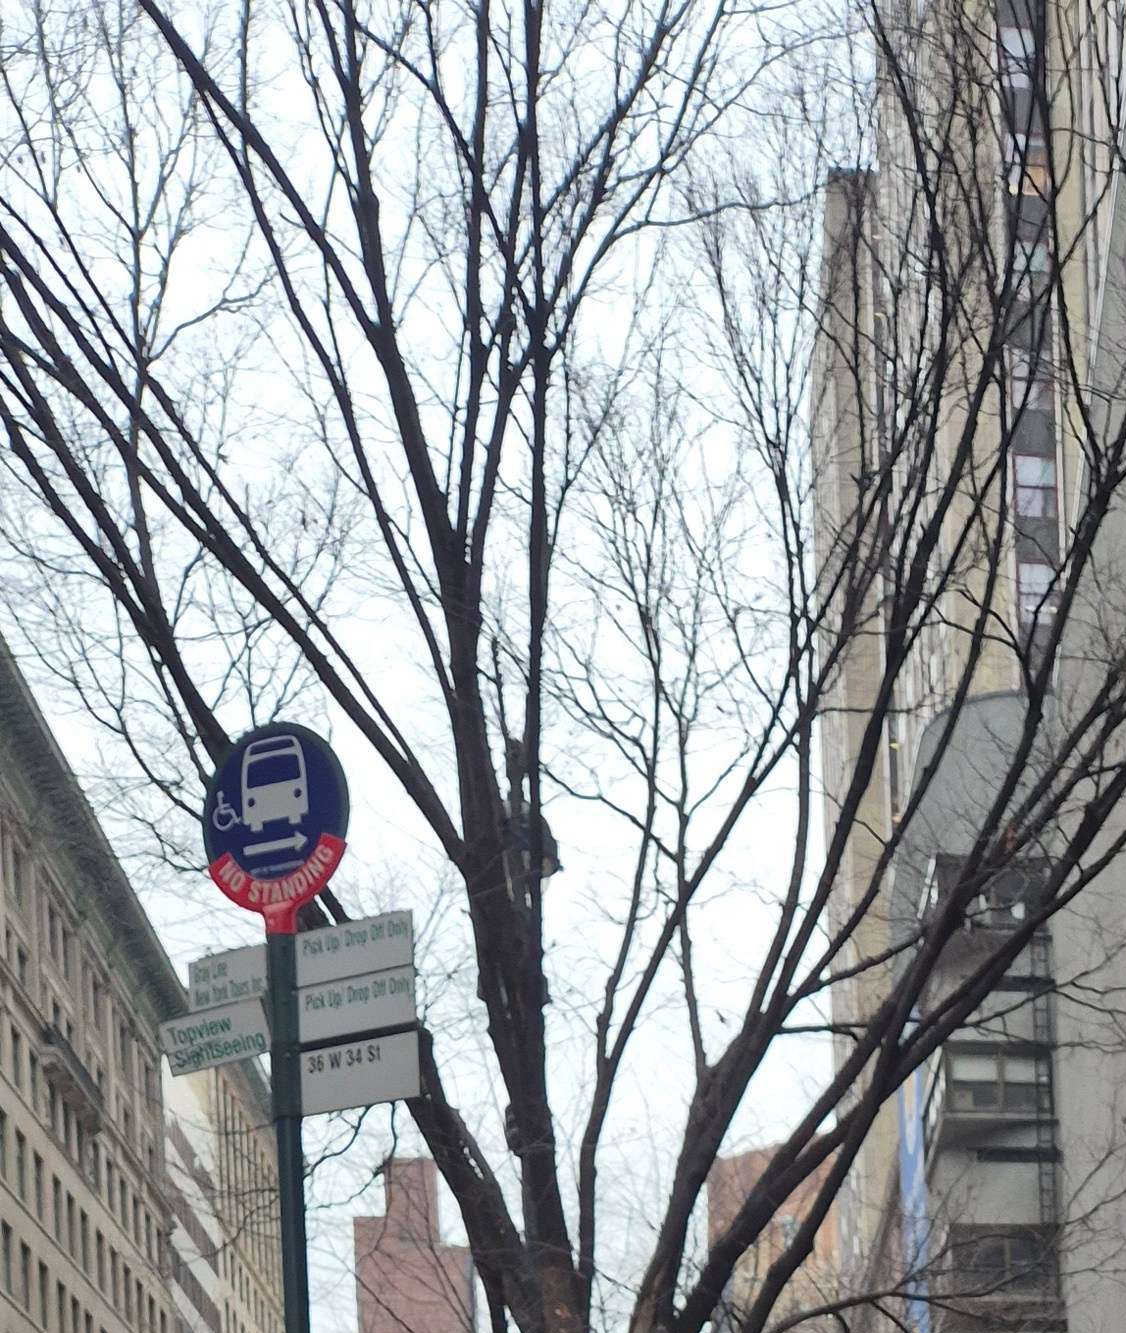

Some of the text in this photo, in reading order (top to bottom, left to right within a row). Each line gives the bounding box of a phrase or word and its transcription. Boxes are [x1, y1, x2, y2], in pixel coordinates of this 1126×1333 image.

[218, 844, 334, 905] NO STANDING
[302, 938, 323, 957] Pick
[345, 929, 368, 948] Drop
[370, 922, 384, 941] Off
[387, 920, 407, 938] Only
[305, 993, 326, 1012] Pick
[346, 984, 370, 1005] Drop
[372, 978, 386, 998] Off
[389, 976, 410, 997] Only
[167, 1016, 231, 1046] Topview
[173, 1032, 267, 1068] Sightseeing
[328, 1050, 342, 1069] W
[346, 1047, 363, 1066] 34
[367, 1044, 381, 1063] St
